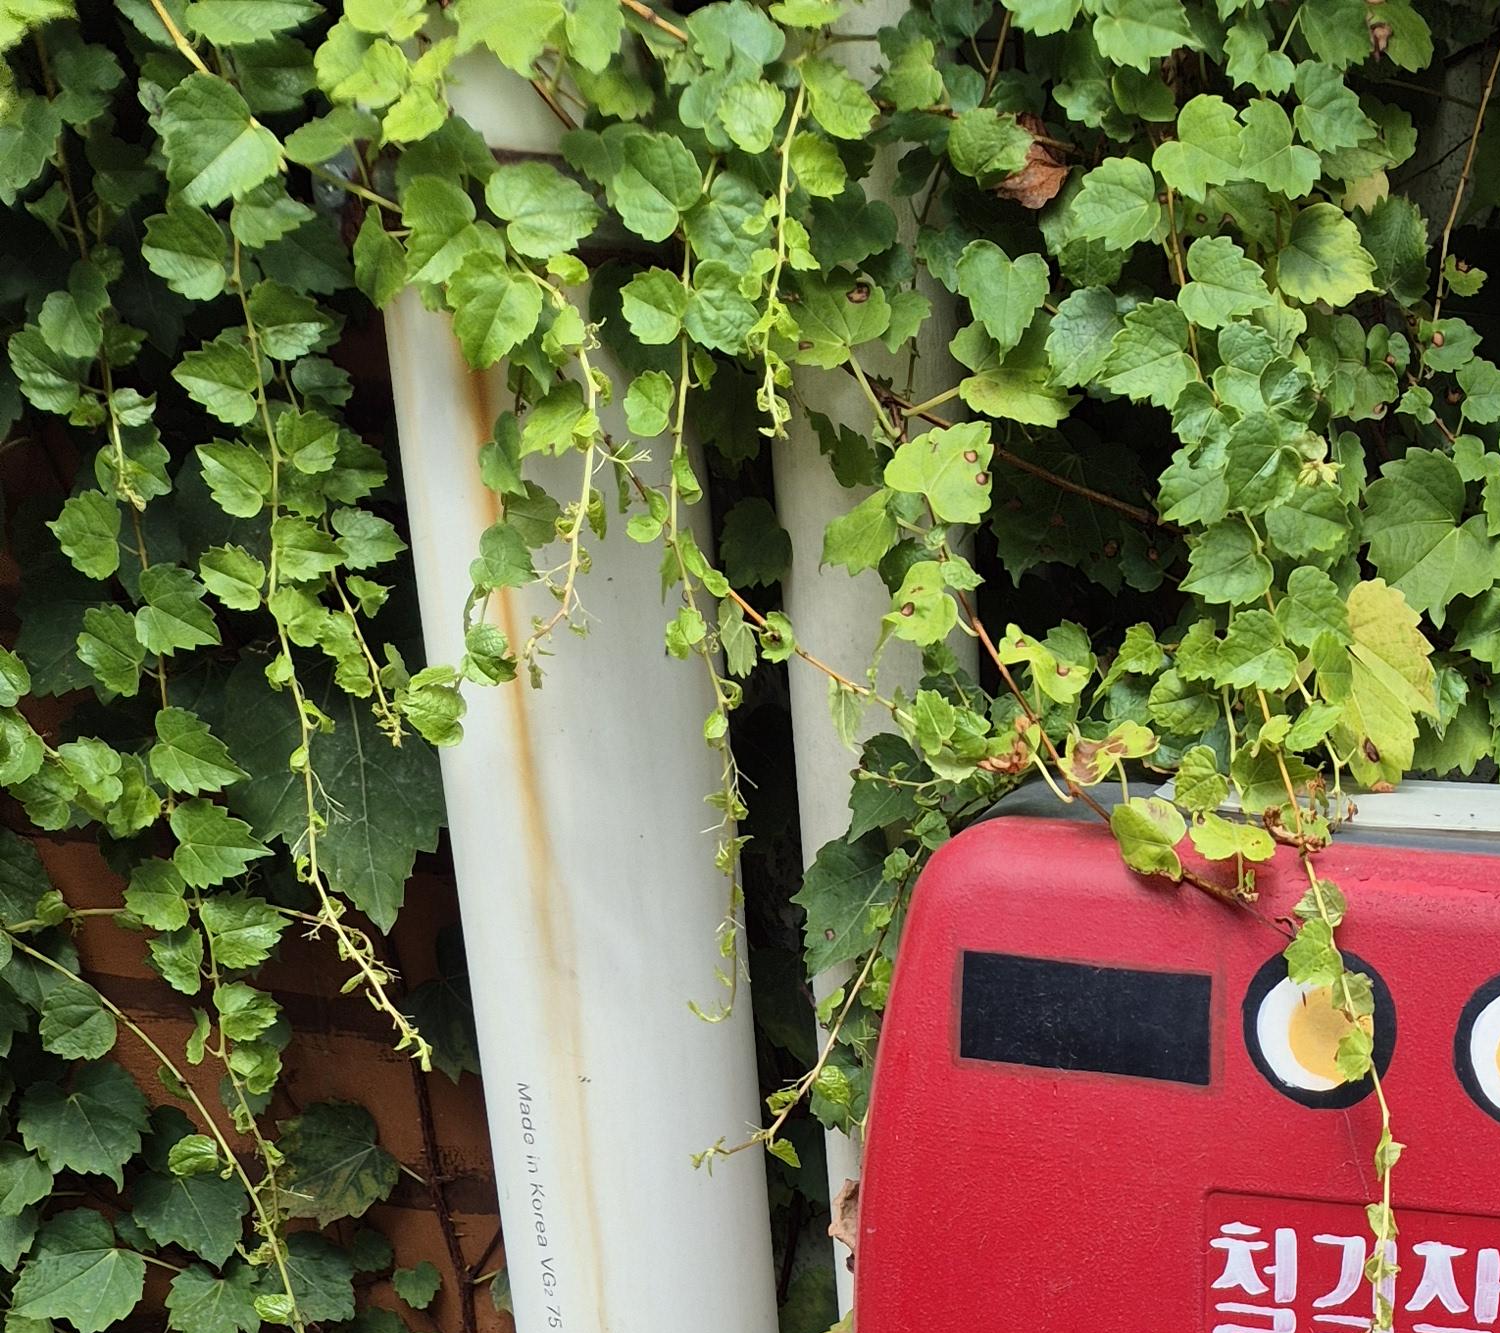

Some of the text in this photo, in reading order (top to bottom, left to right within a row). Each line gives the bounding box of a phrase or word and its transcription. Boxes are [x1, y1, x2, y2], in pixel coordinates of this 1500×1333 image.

[516, 1082, 535, 1145] Made
[526, 1155, 540, 1175] in
[529, 1182, 548, 1248] Korea
